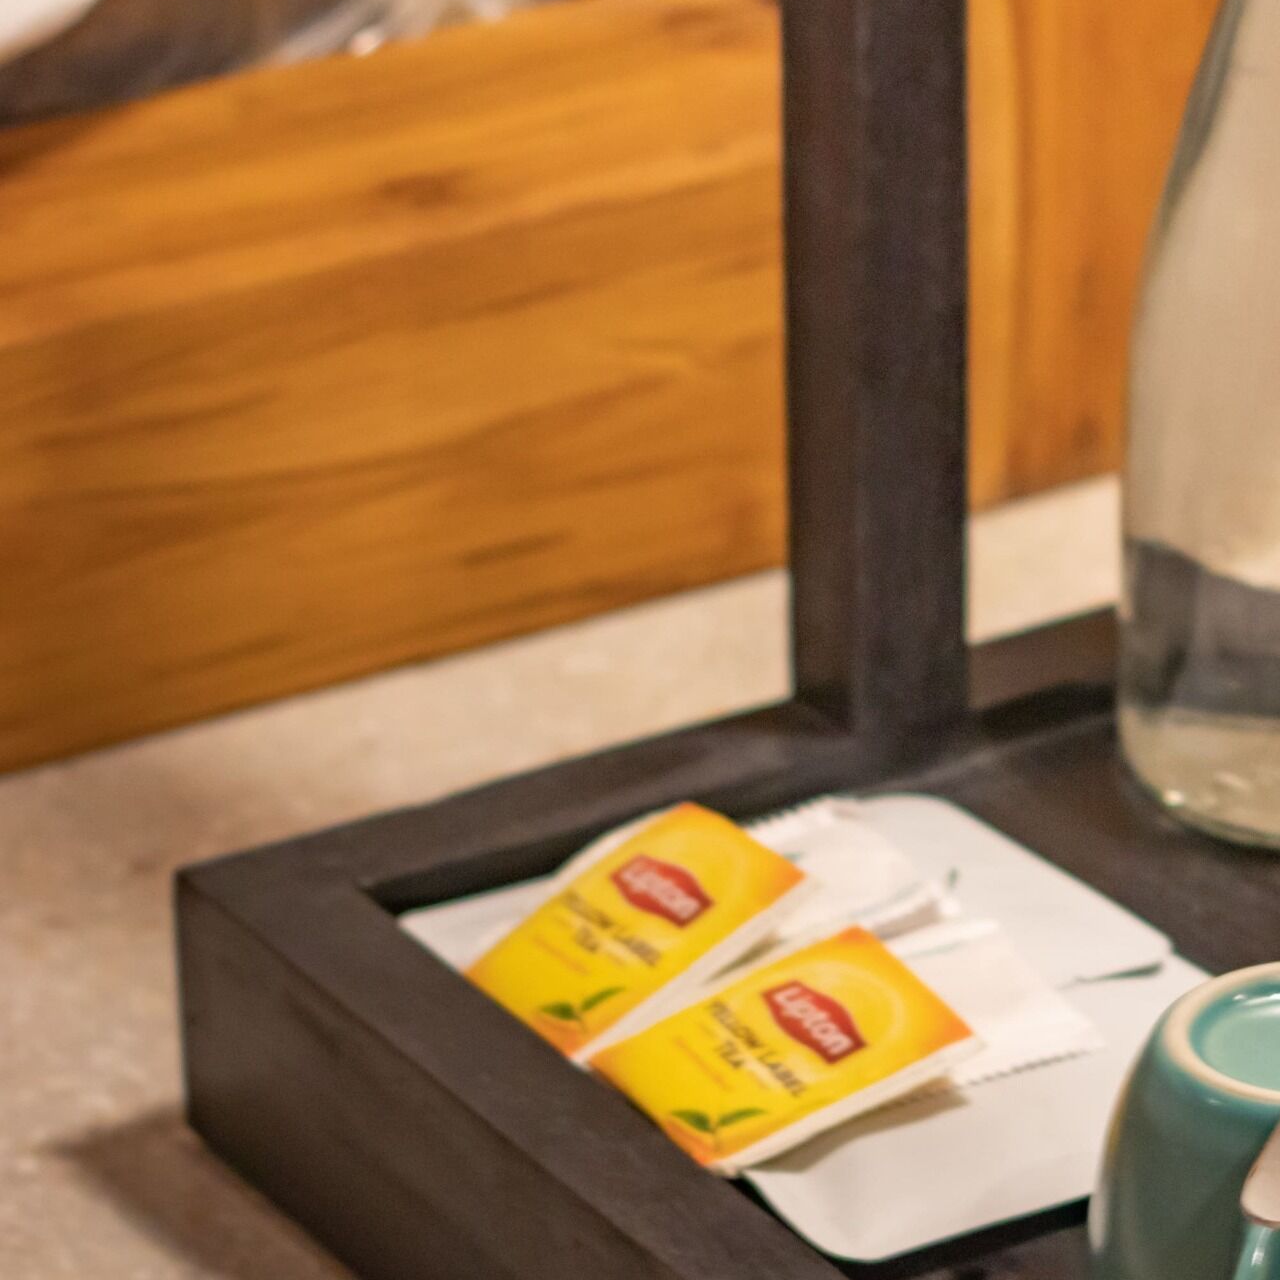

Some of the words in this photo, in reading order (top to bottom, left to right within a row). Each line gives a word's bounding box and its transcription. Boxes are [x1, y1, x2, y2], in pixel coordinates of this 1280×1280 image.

[618, 864, 702, 920] Lipton
[708, 999, 763, 1050] YELLOW
[756, 1049, 808, 1098] LABEL
[771, 985, 855, 1056] Lipton
[713, 1038, 745, 1070] TEA
